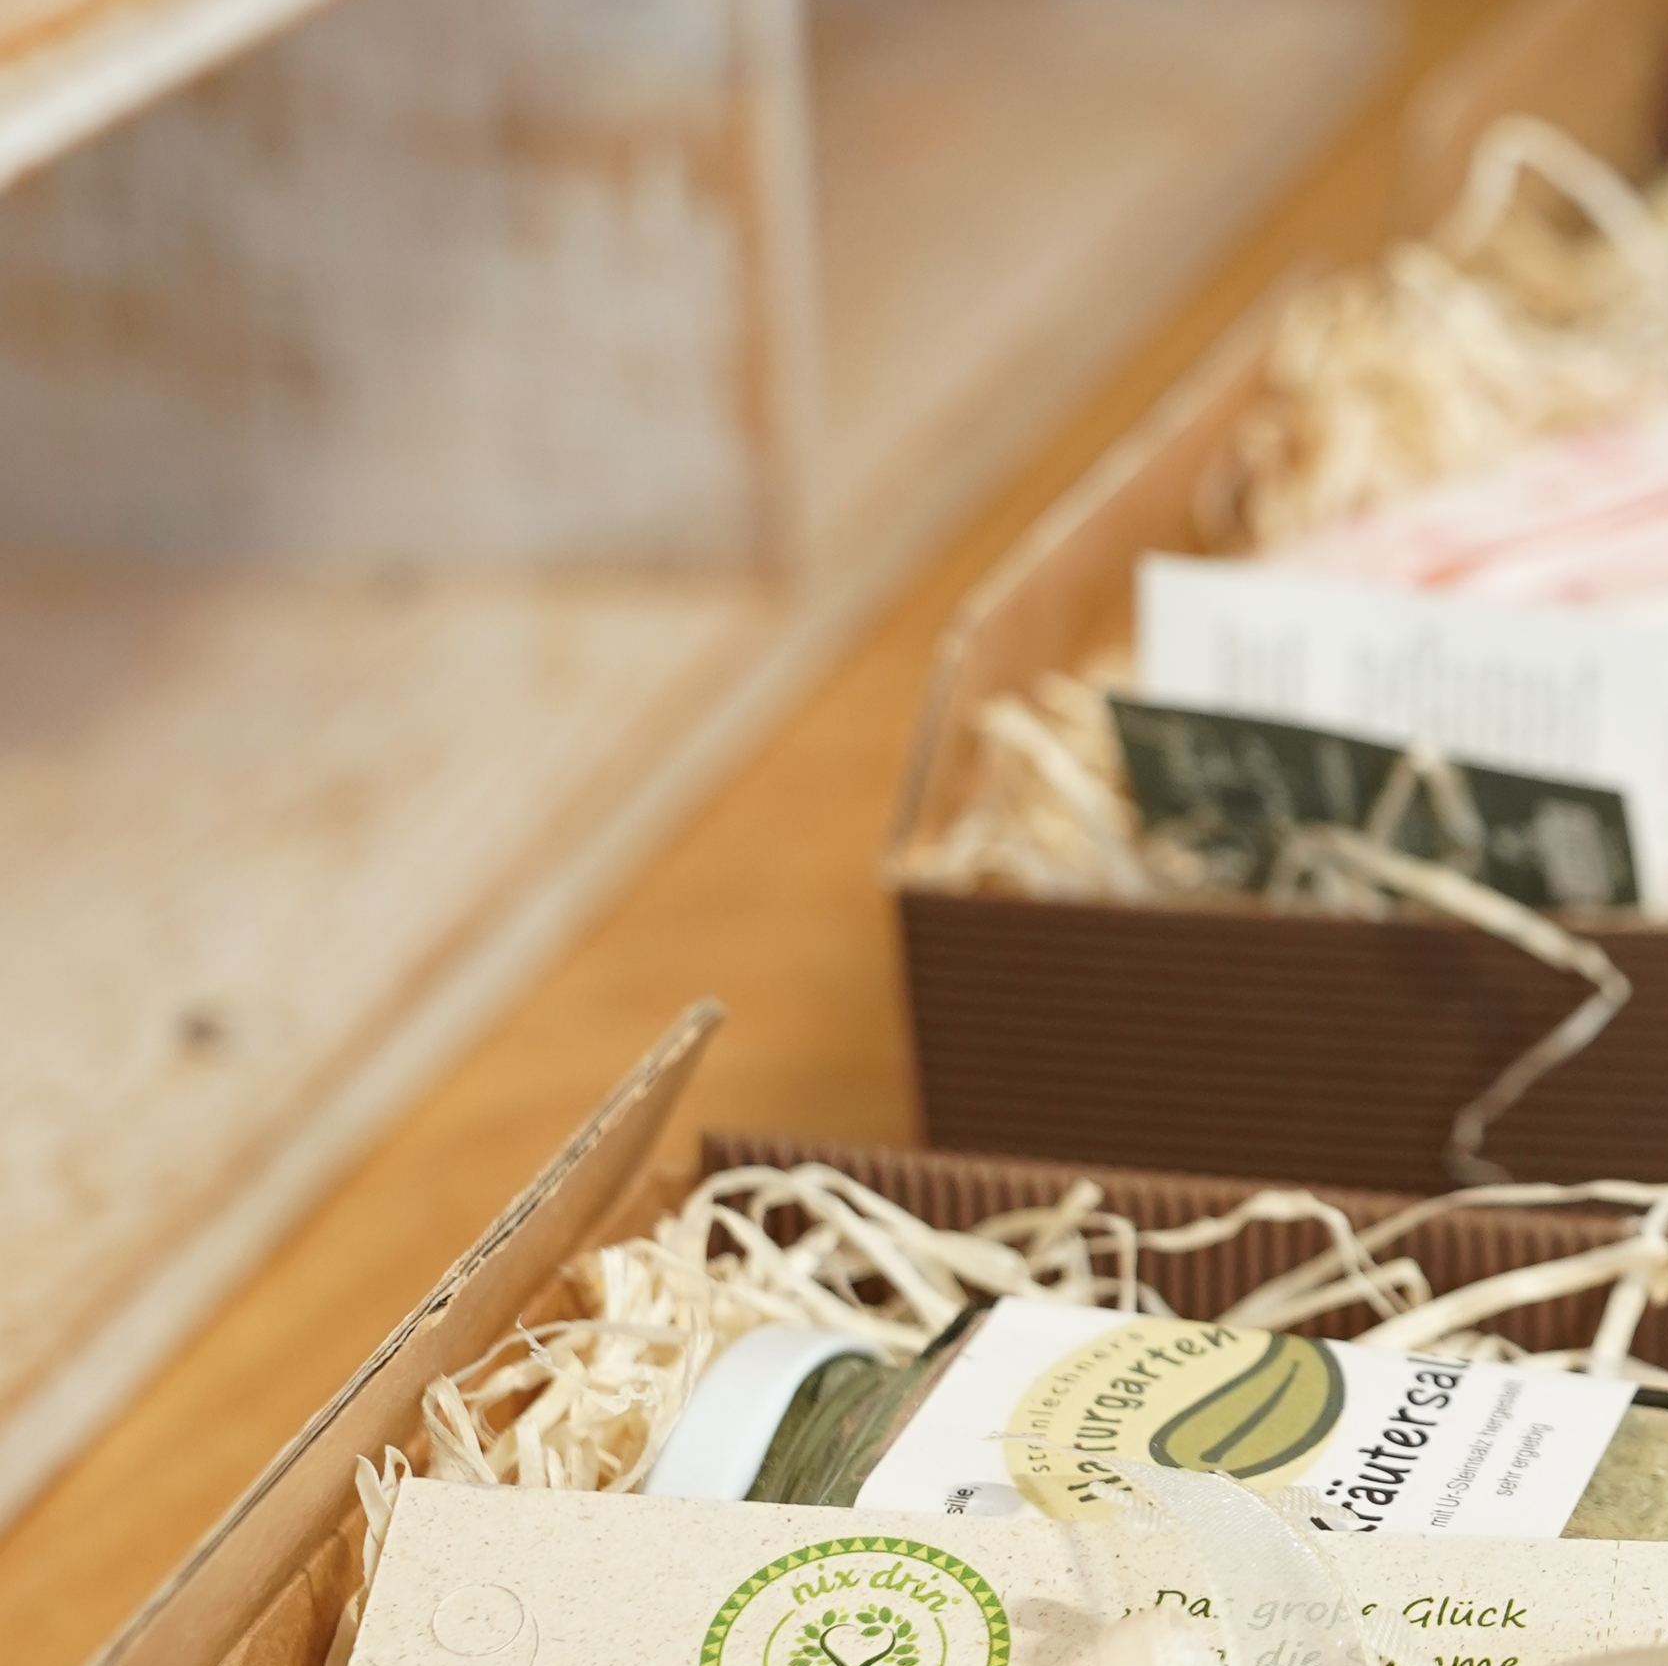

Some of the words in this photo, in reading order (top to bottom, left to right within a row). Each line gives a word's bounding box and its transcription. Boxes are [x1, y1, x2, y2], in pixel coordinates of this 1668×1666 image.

[1439, 1438, 1494, 1509] Ur-Steinsalz
[1495, 1468, 1521, 1497] sehr
[1511, 1421, 1555, 1468] ergiebig
[1430, 1509, 1455, 1528] mit
[792, 1563, 860, 1605] nix
[1402, 1595, 1528, 1630] Glück
